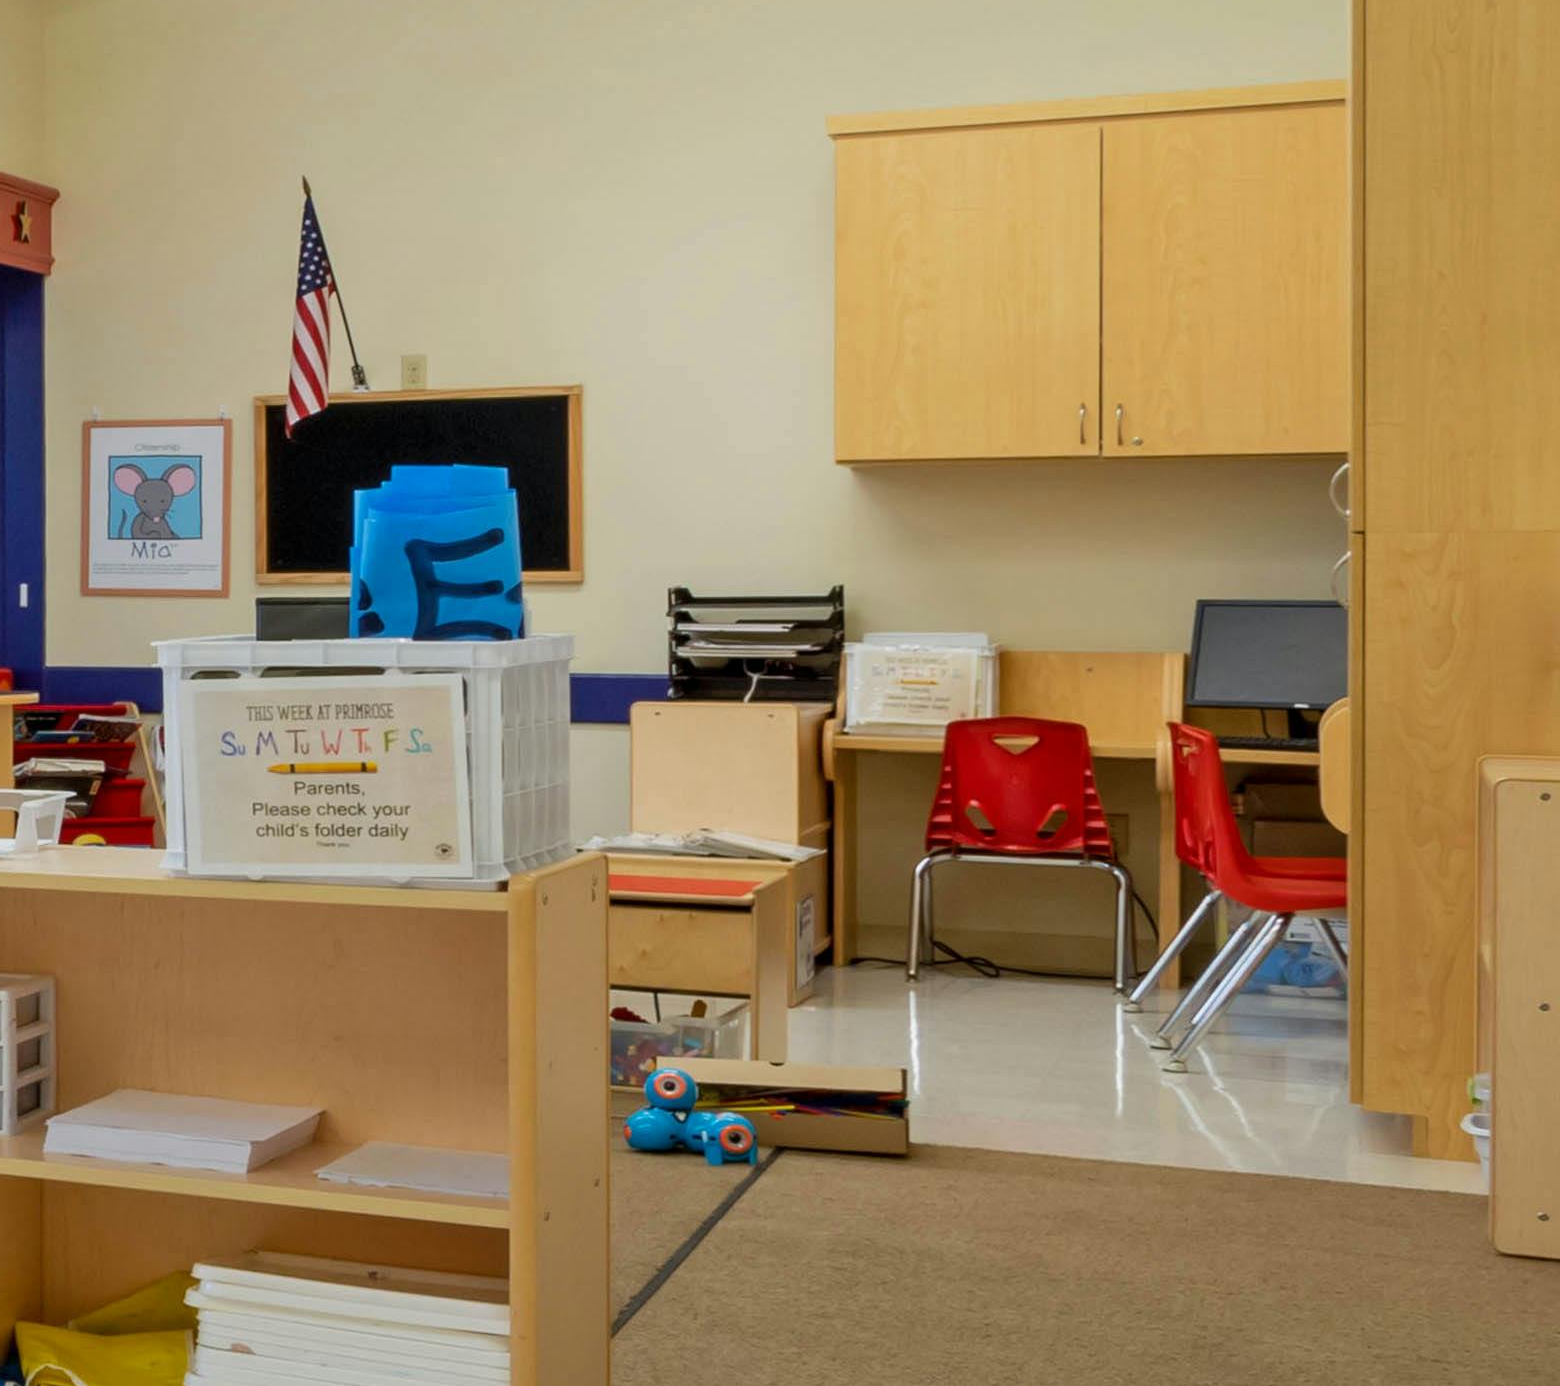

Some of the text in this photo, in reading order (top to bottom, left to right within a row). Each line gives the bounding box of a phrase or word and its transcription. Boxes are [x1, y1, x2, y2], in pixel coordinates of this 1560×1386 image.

[246, 703, 395, 722] THIS WEEK AT PRIMROSE
[220, 731, 246, 757] Su
[256, 730, 279, 756] M
[285, 729, 310, 755] Tu
[321, 729, 344, 756] W
[351, 728, 372, 754] Th
[383, 729, 400, 753] F
[294, 781, 366, 797] Parents,
[252, 801, 411, 820] Please check your
[256, 824, 409, 841] child's folder daily
